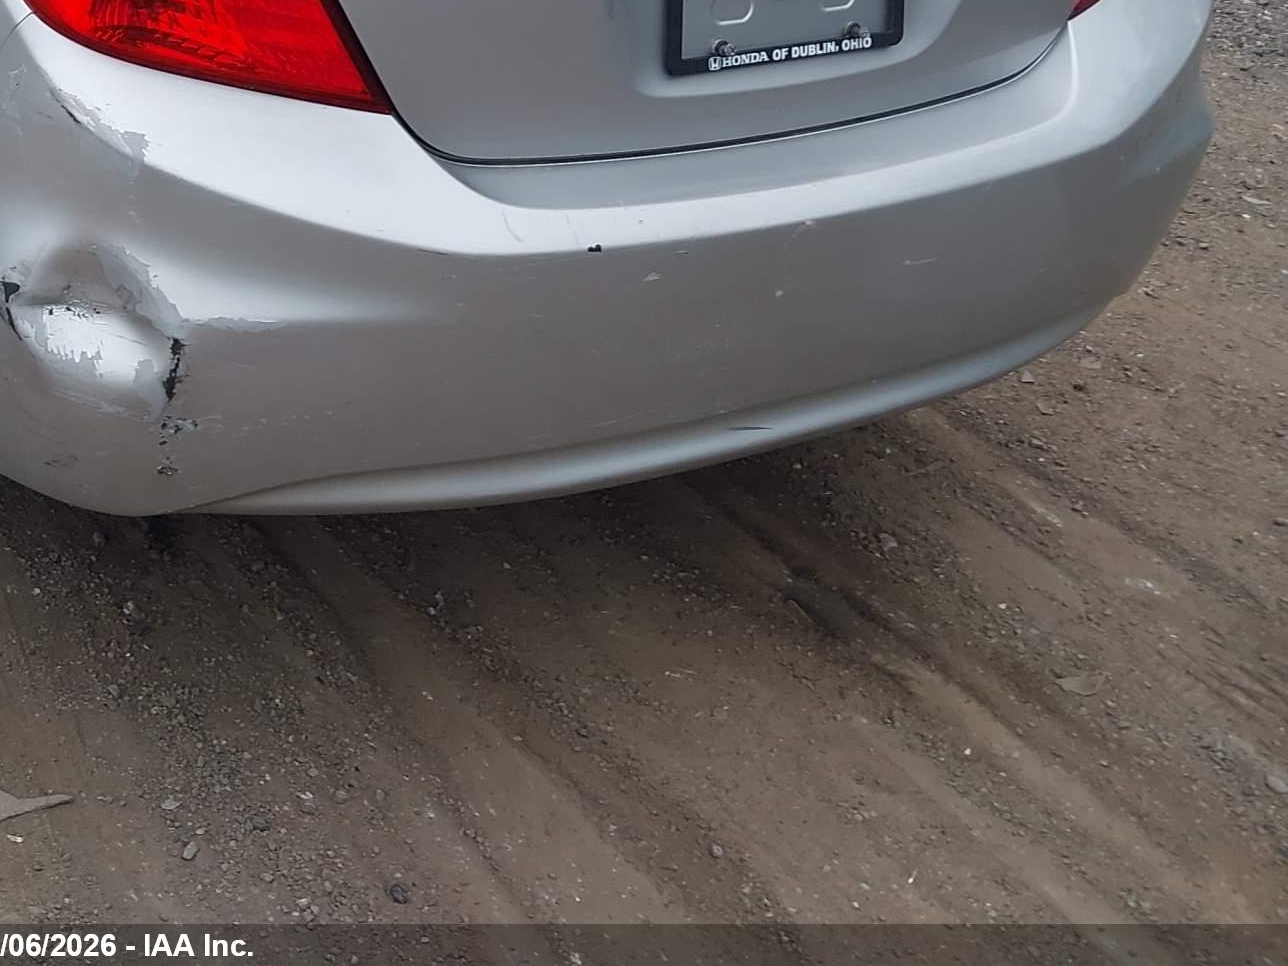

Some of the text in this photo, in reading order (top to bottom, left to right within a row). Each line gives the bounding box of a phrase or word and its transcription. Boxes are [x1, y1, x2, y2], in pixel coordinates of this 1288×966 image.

[721, 52, 770, 68] HONDA
[772, 49, 789, 61] OF
[841, 37, 872, 51] OHIO
